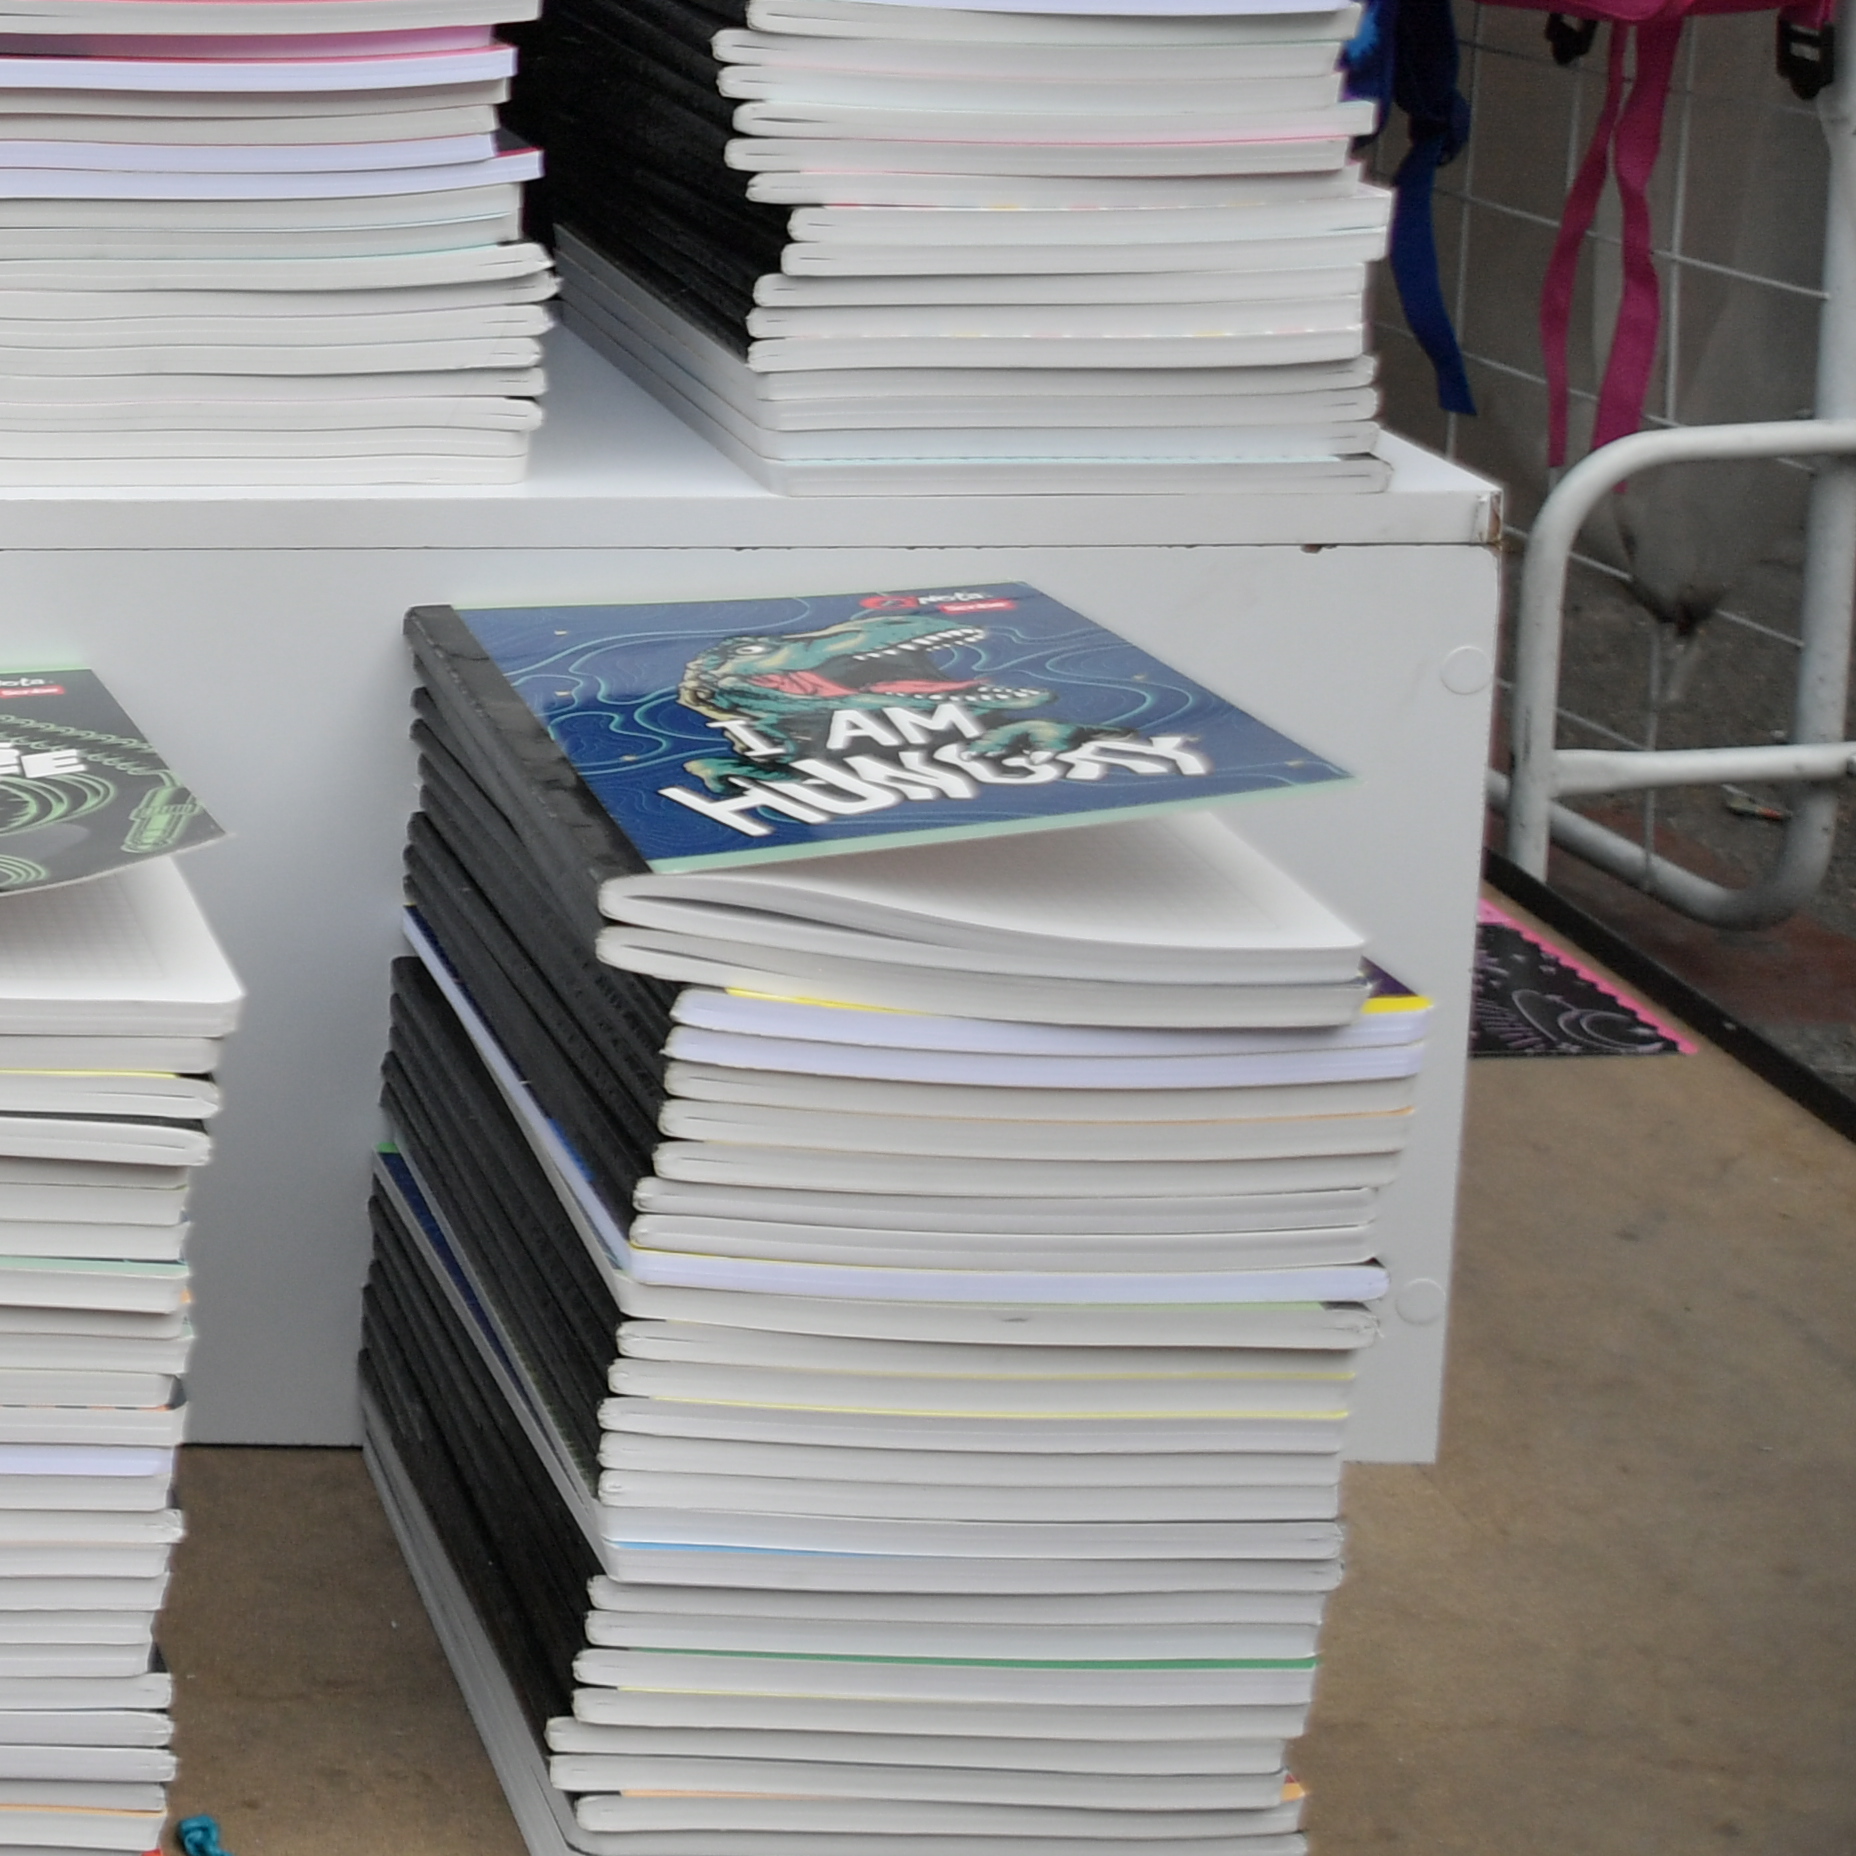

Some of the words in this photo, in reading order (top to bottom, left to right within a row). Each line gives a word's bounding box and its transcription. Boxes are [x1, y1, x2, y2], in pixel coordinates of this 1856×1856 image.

[707, 718, 788, 760] I
[825, 701, 988, 750] AM
[657, 735, 1214, 838] HUNGRY
